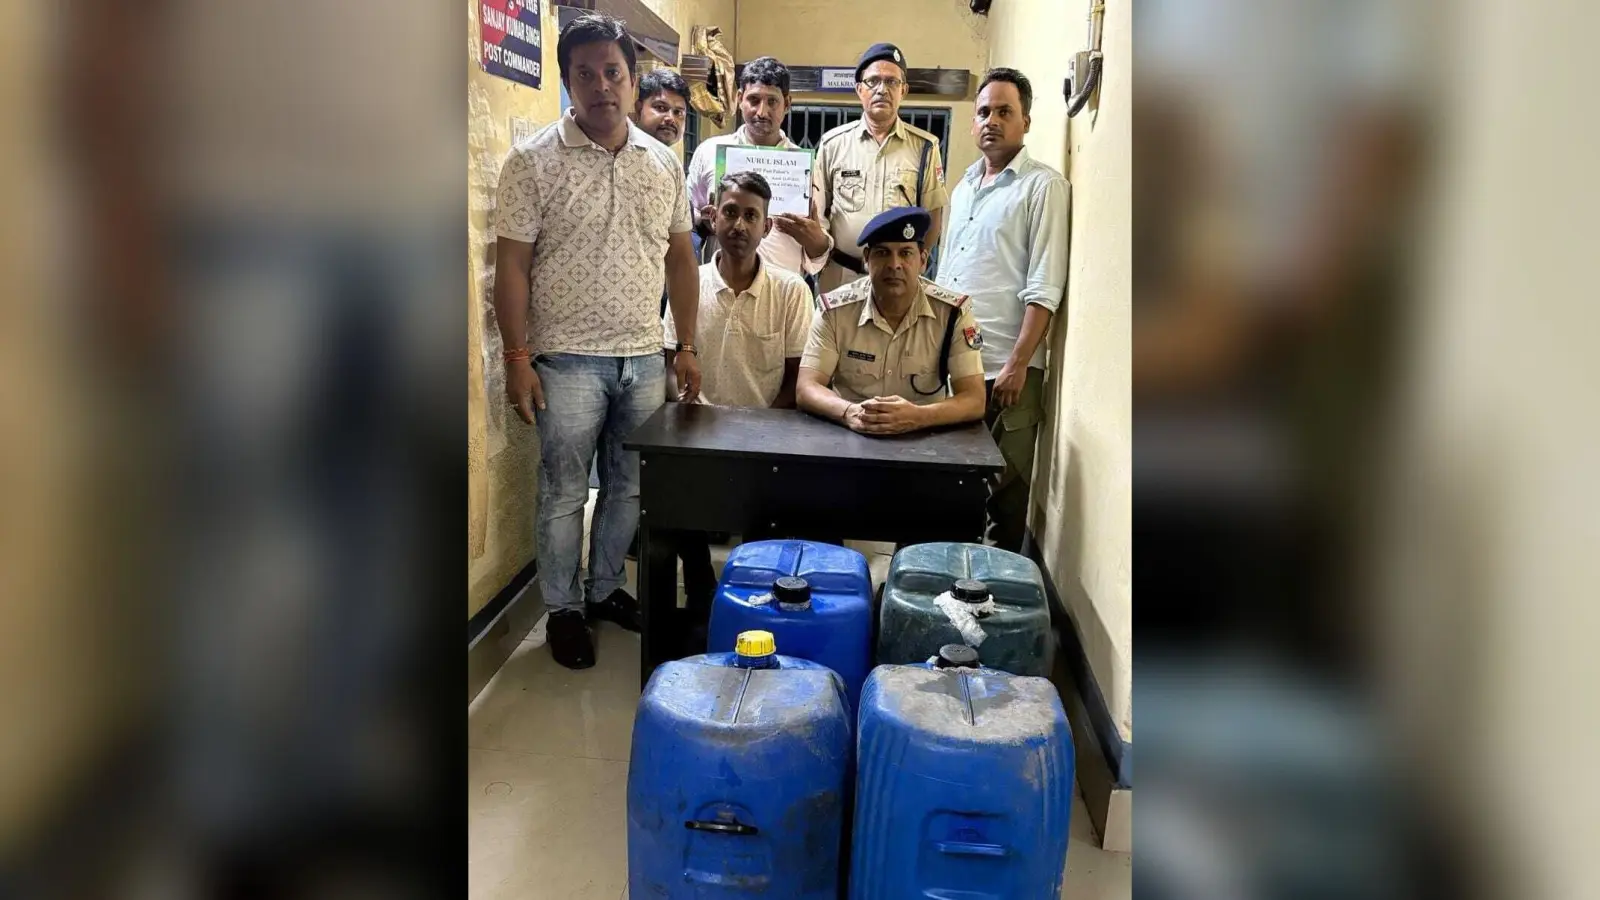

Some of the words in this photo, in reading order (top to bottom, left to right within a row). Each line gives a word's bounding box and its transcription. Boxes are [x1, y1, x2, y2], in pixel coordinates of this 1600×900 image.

[483, 4, 505, 31] SANJAY
[506, 15, 525, 41] KUMAR
[525, 24, 540, 48] SINGH
[484, 41, 501, 63] POST
[503, 49, 540, 77] COMMANDER
[746, 156, 771, 165] NURUL
